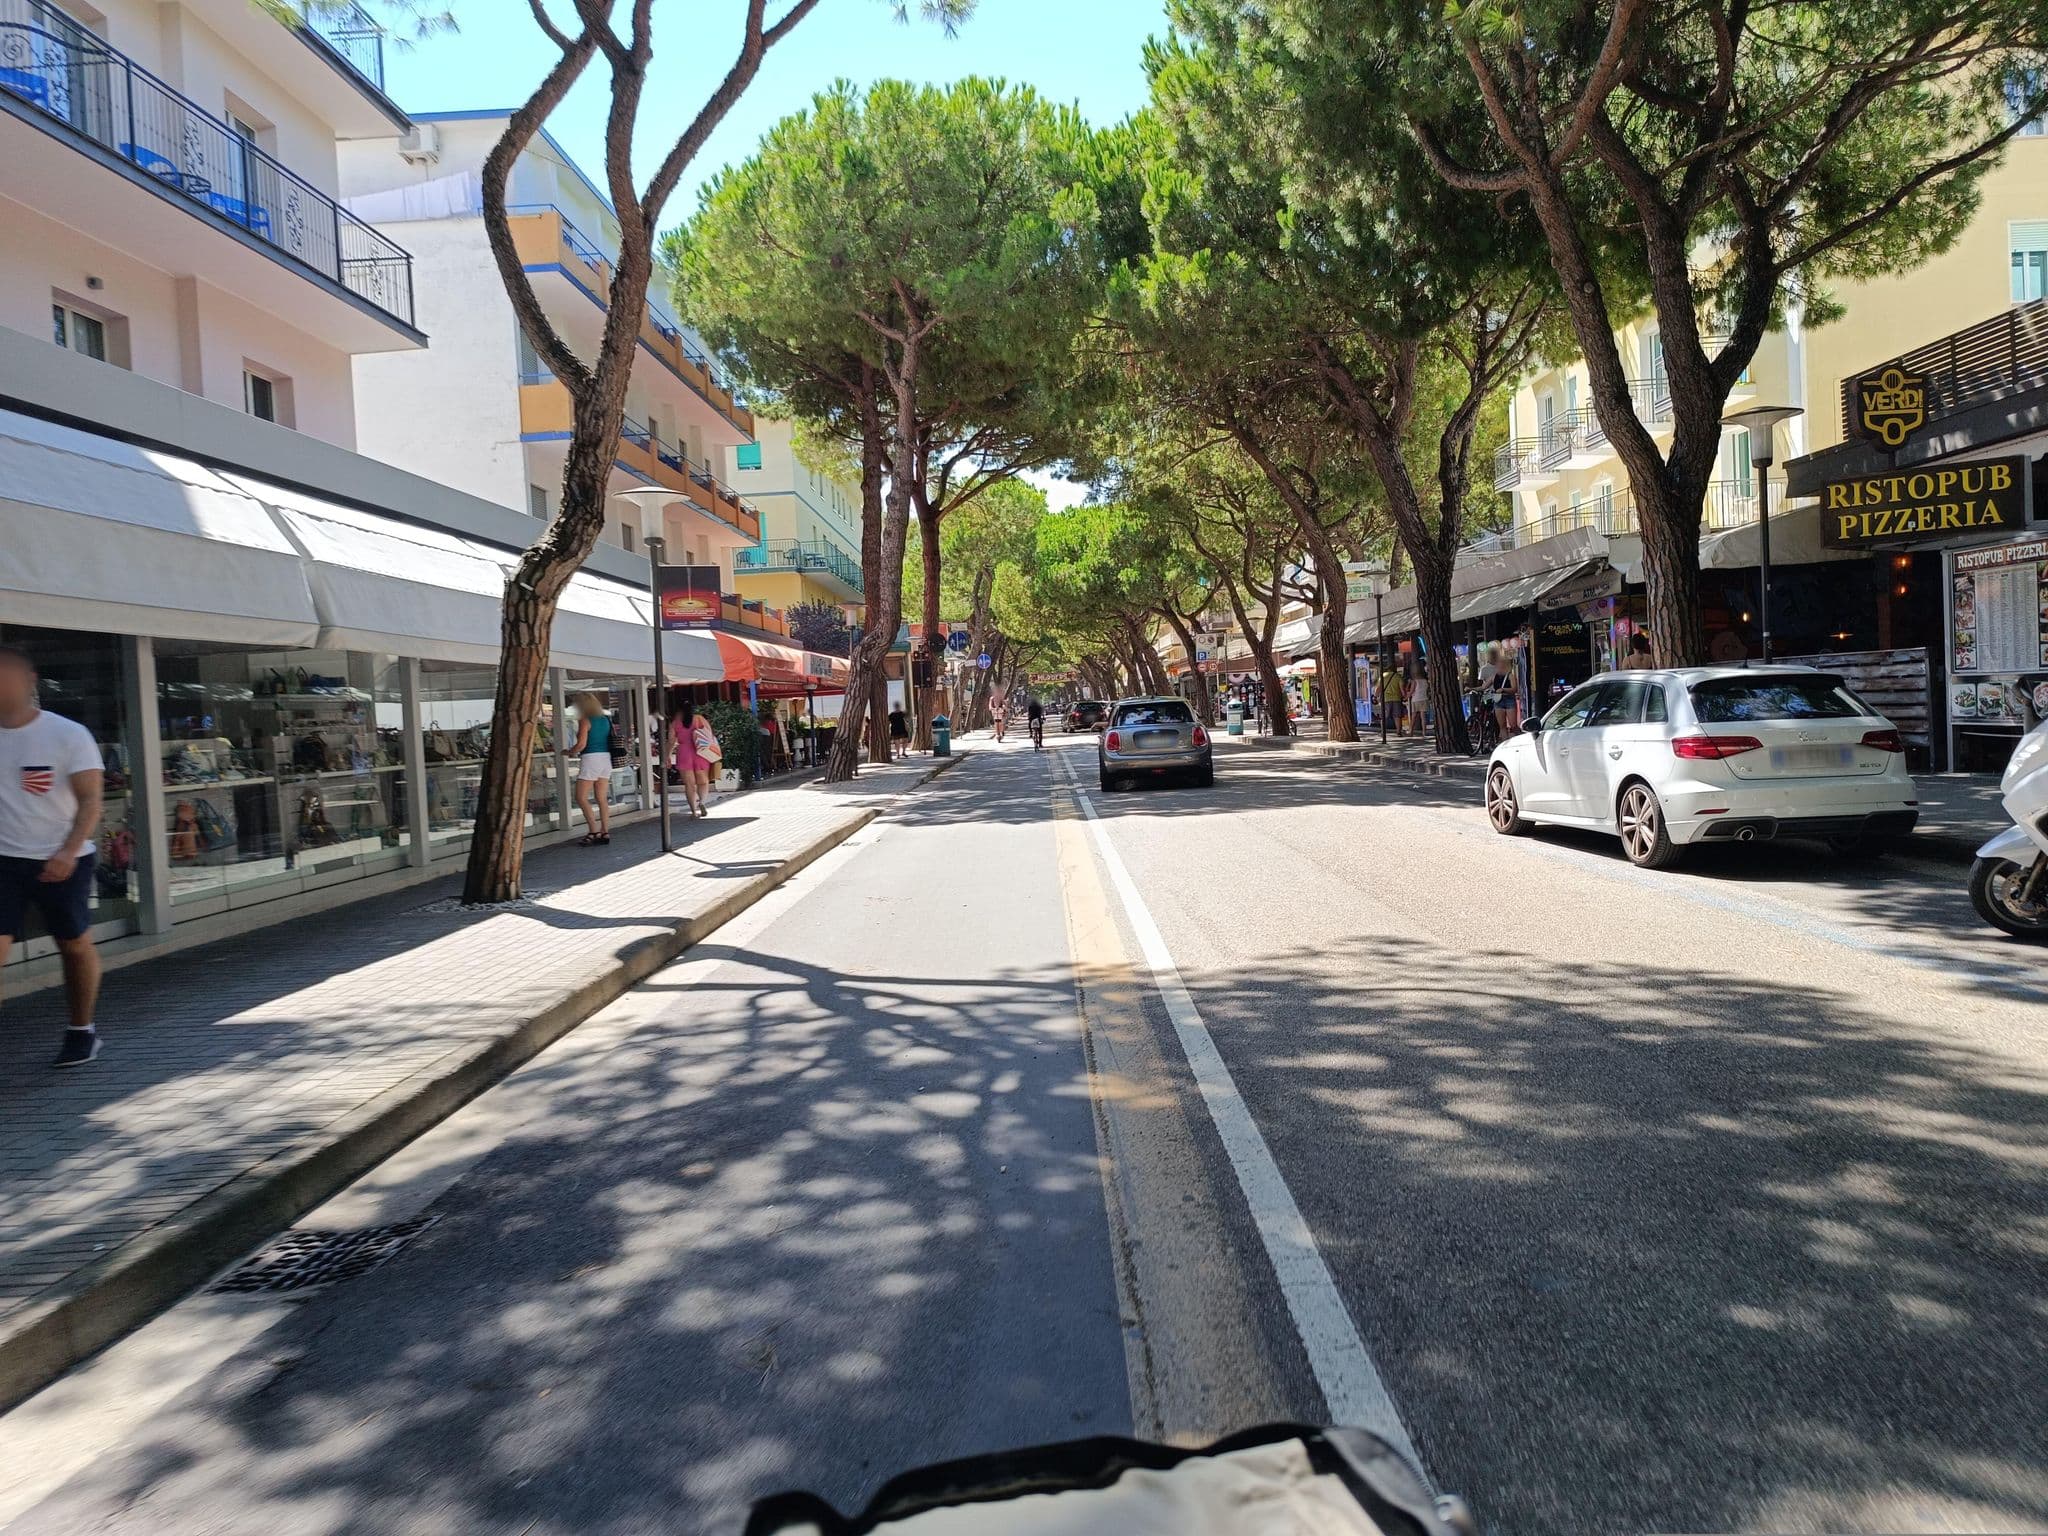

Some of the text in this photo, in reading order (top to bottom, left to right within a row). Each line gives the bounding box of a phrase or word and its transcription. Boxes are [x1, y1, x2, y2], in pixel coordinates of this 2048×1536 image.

[1863, 389, 1923, 410] VERDI
[1827, 464, 2012, 509] RISTOPUB
[1838, 499, 2004, 540] PIZZERIA
[1957, 542, 2048, 569] RISTOPUB PIZZERI
